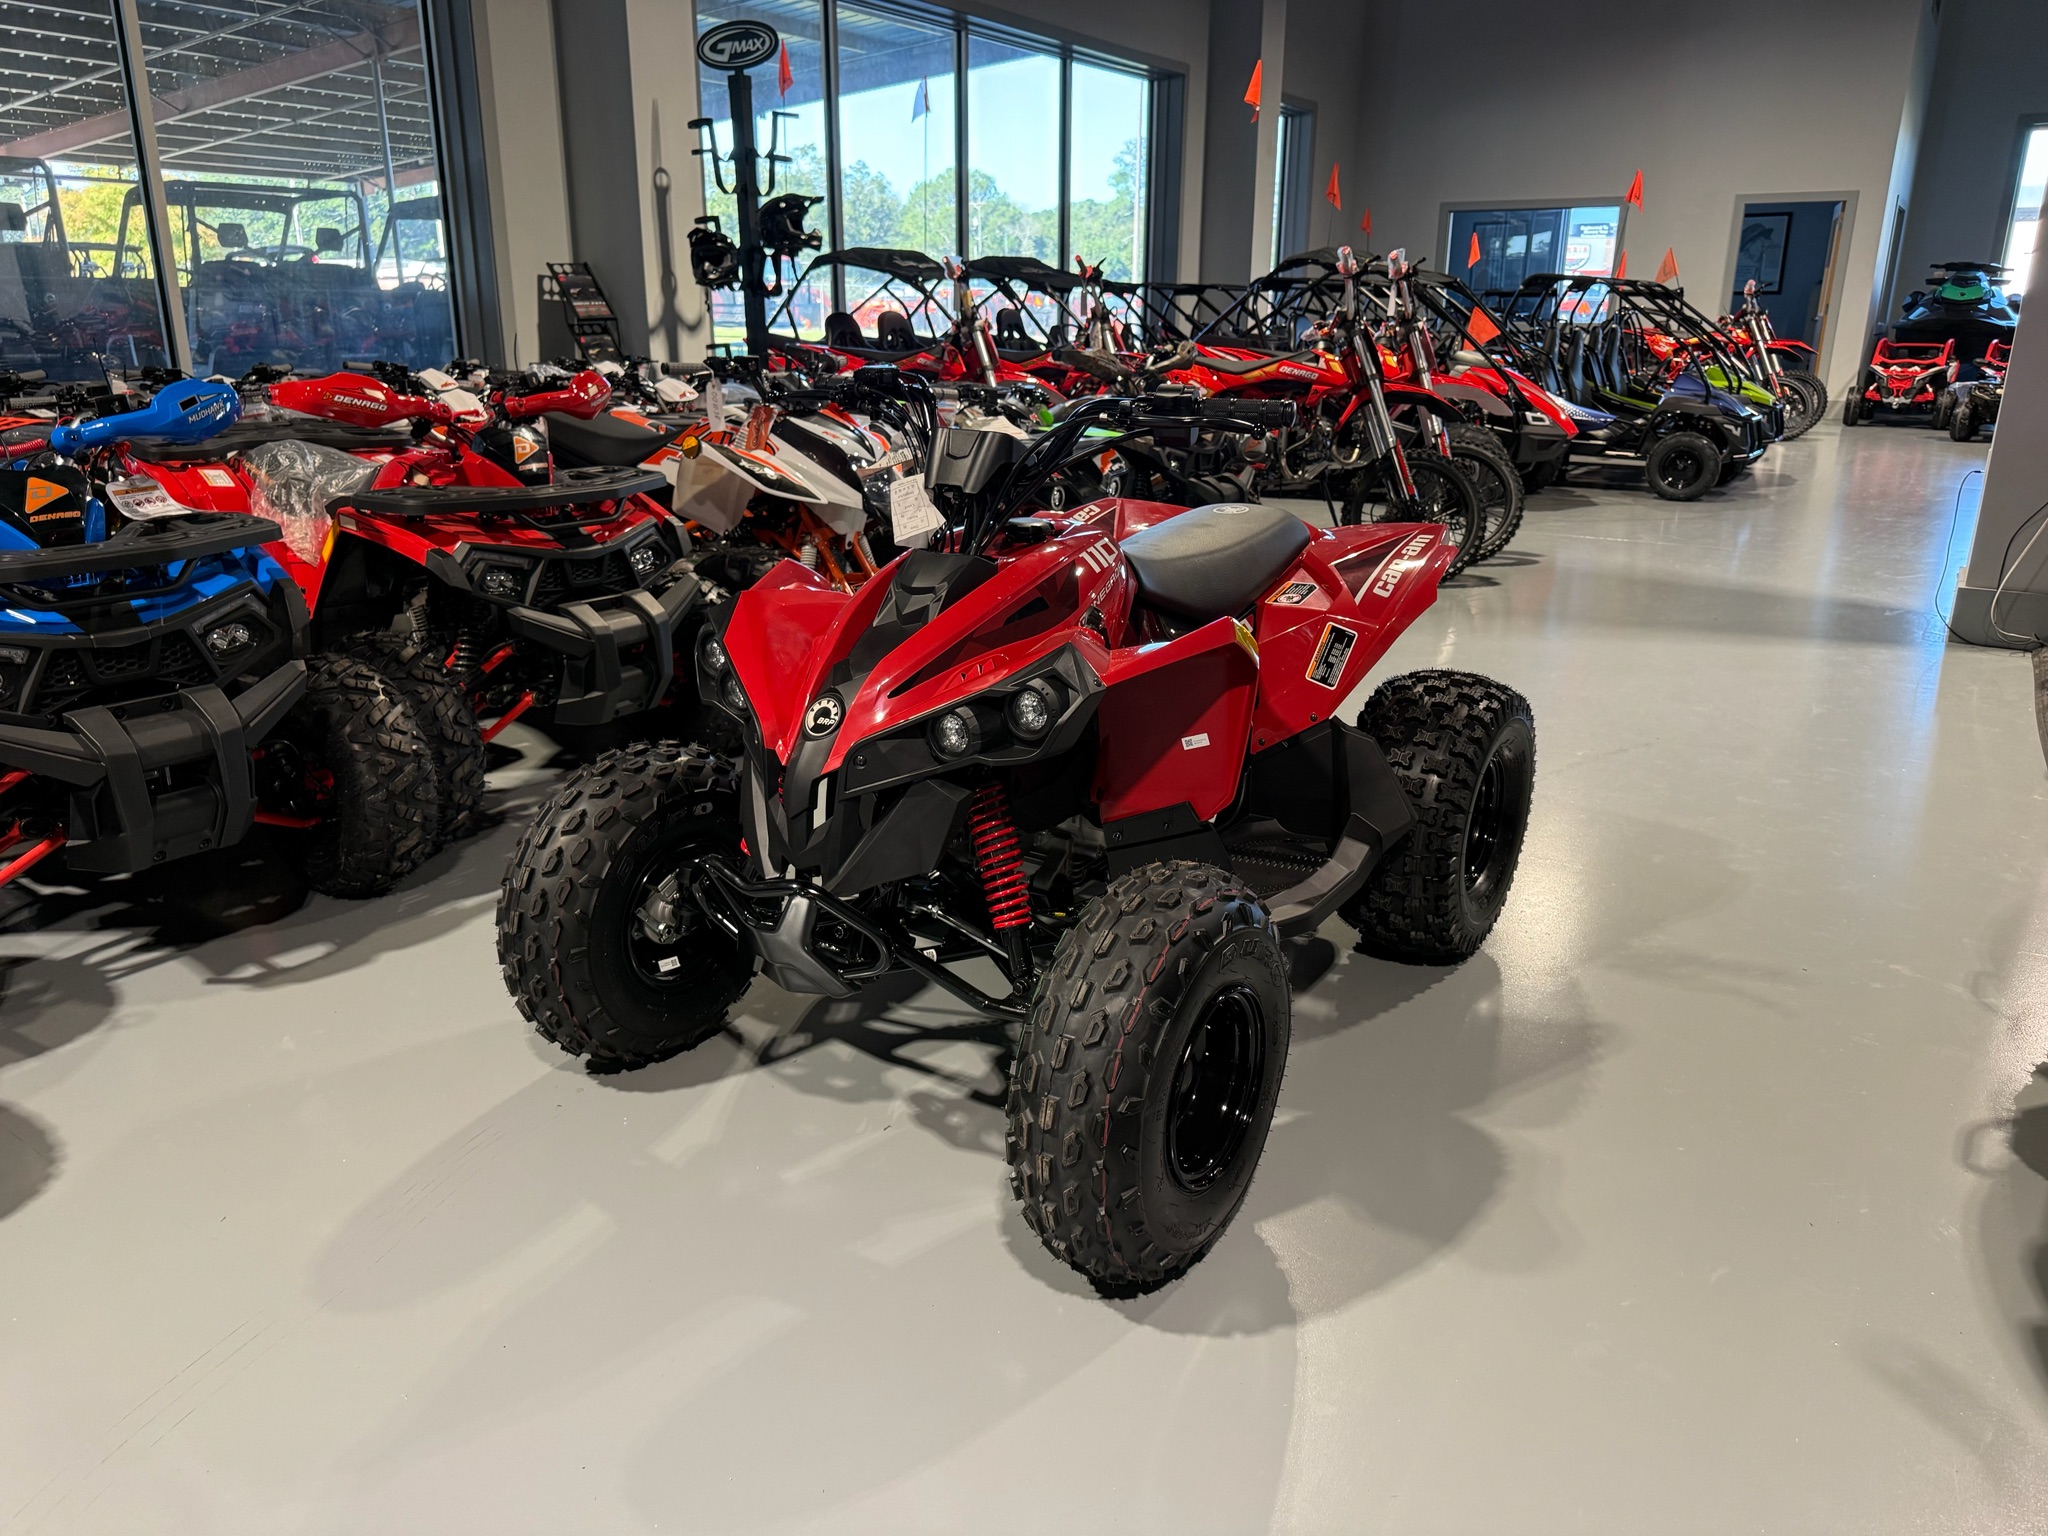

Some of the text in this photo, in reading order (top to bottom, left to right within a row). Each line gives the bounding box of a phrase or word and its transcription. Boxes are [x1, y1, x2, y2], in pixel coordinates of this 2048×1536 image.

[702, 29, 771, 63] GMAX
[1279, 366, 1319, 380] DENAGO
[188, 401, 225, 424] MUDHAWK
[333, 394, 388, 412] DENAGO
[30, 510, 81, 523] DENAGO
[1079, 537, 1119, 573] 110
[1372, 534, 1435, 598] can-am
[816, 717, 835, 726] BRP
